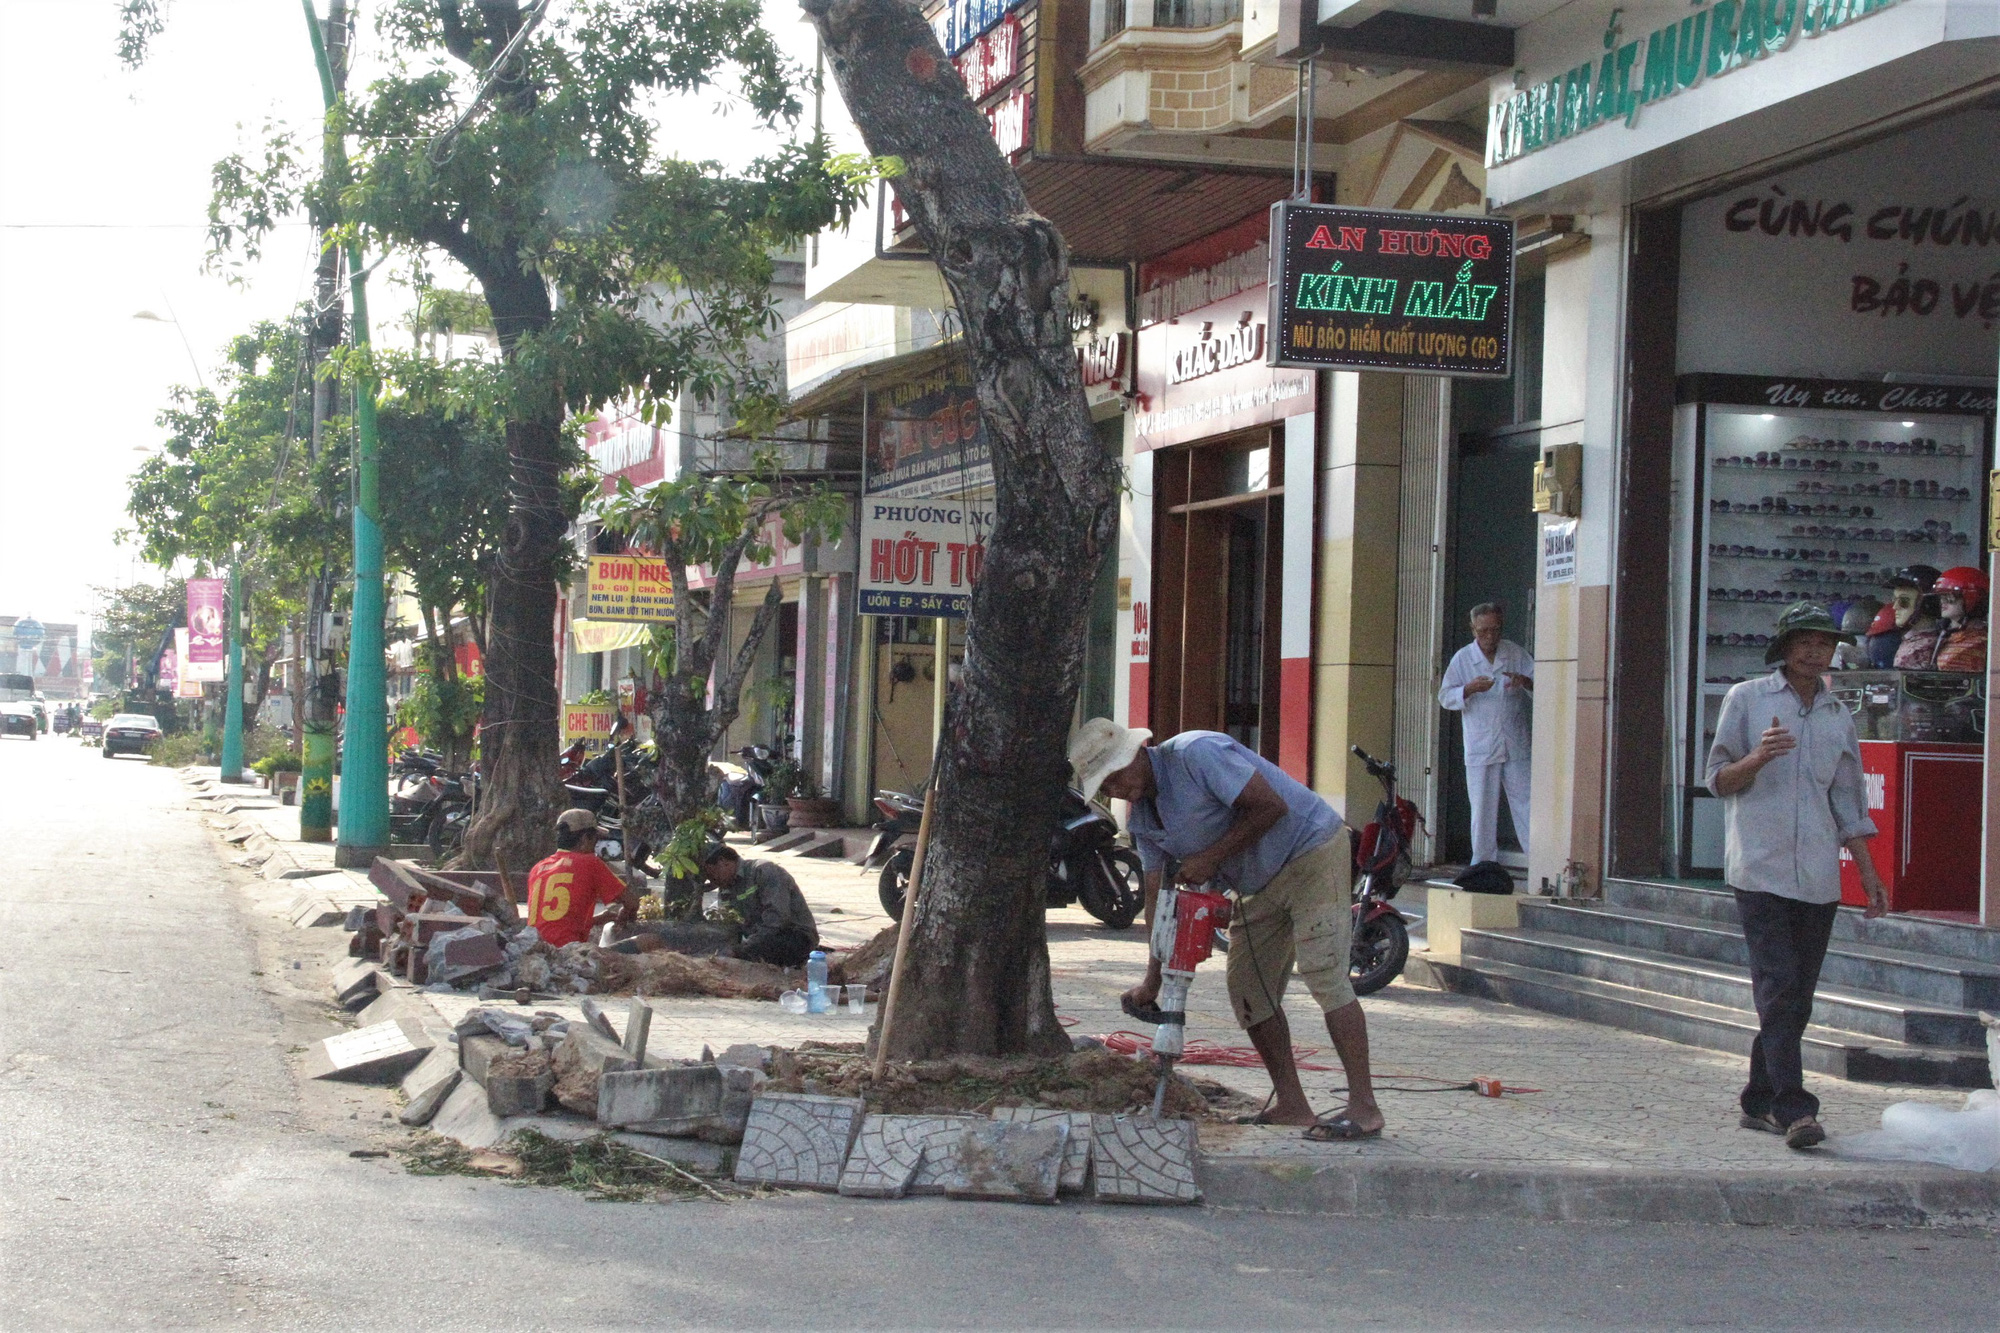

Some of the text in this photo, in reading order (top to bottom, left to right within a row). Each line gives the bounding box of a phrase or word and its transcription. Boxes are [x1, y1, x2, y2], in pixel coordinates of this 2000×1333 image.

[1484, 70, 1561, 169] KÍNH
[1725, 184, 2000, 247] CÙNG CHÚN
[1306, 225, 1492, 259] AN HƯNG
[1296, 260, 1398, 314] KÍNH
[1403, 260, 1498, 320] MẮT
[1851, 262, 2000, 329] BẢO VỆ
[1218, 311, 1265, 370] DẤU
[1292, 318, 1498, 363] MŨ BẢO HIỂM CHẤT LƯỢNG CAO
[1765, 384, 1811, 406] Uy
[1879, 386, 1948, 410] Chất
[873, 505, 962, 524] PHƯƠNG
[599, 559, 634, 580] BÚN
[870, 530, 986, 587] HỚT TÓ
[591, 593, 610, 602] NEM
[867, 591, 891, 607] UỐN
[920, 593, 943, 609] SẤY
[951, 597, 967, 613] GỘ
[568, 709, 588, 732] CHÈ
[528, 872, 575, 926] 15
